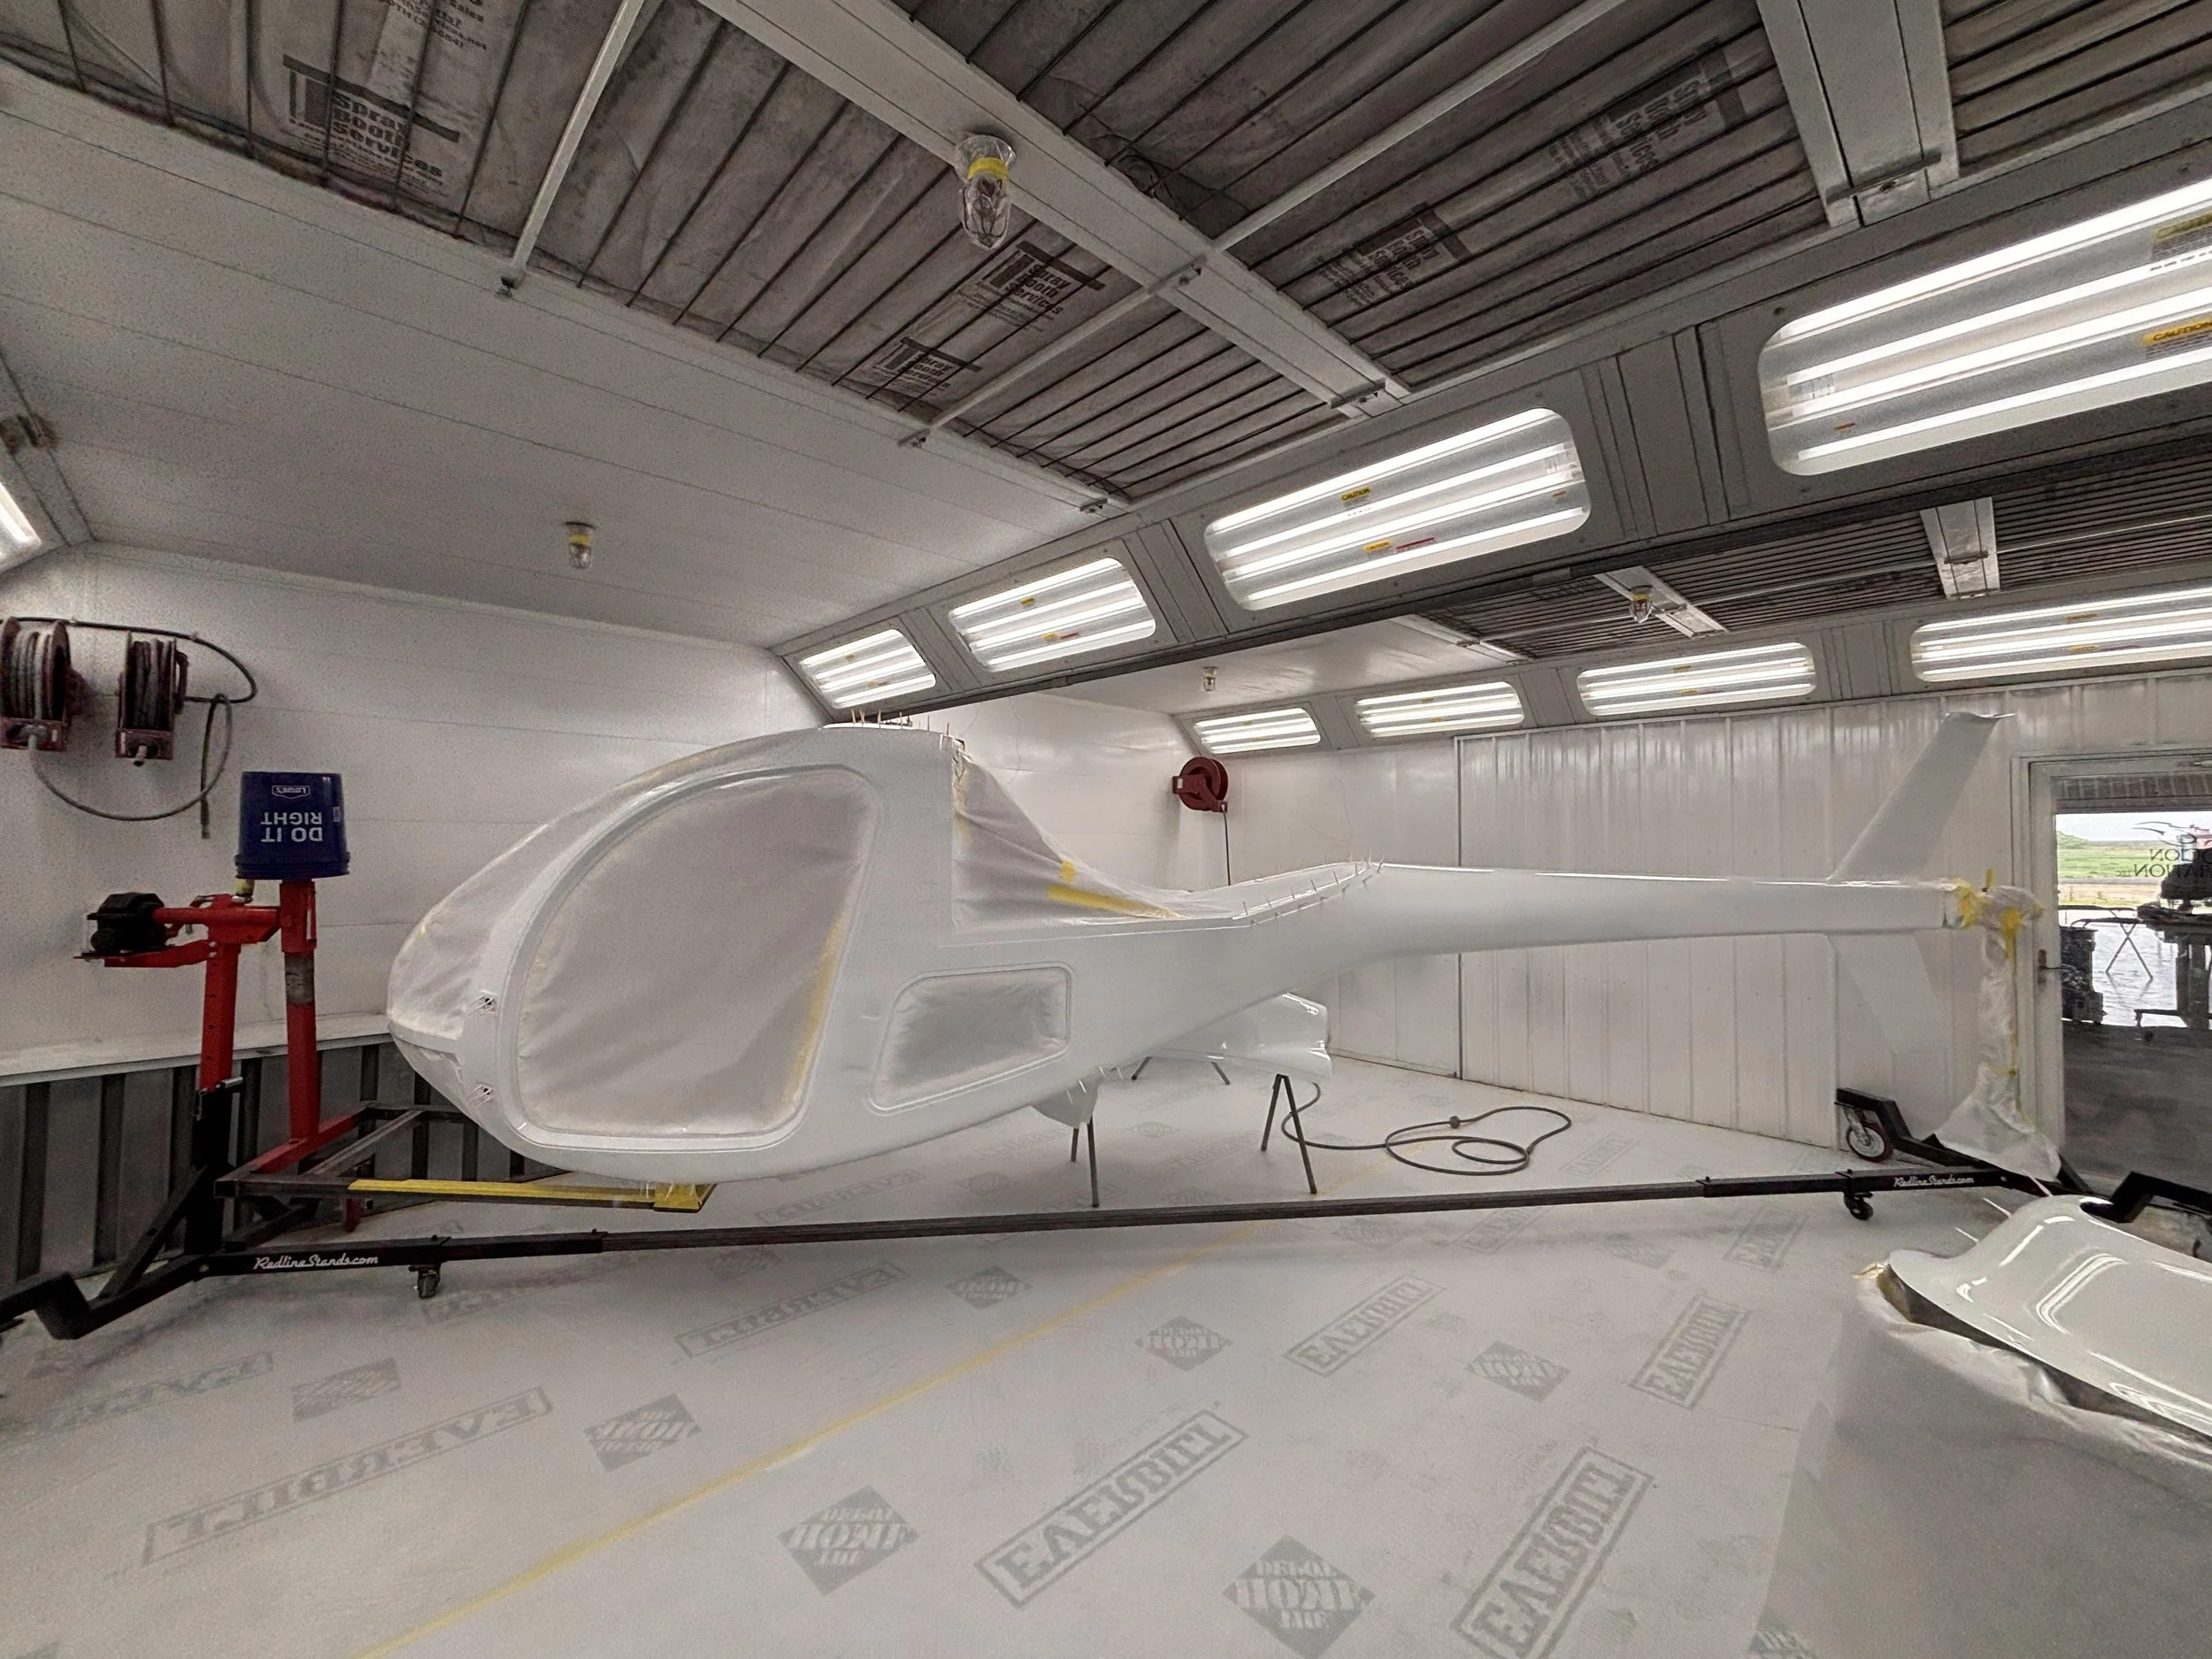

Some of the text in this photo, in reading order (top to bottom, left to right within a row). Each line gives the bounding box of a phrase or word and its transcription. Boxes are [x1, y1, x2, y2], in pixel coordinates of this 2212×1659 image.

[331, 90, 409, 134] Spray
[331, 106, 407, 149] Booth
[260, 811, 323, 826] RIGHT
[260, 826, 324, 842] DO IT
[253, 1252, 380, 1271] RedlineStands.com
